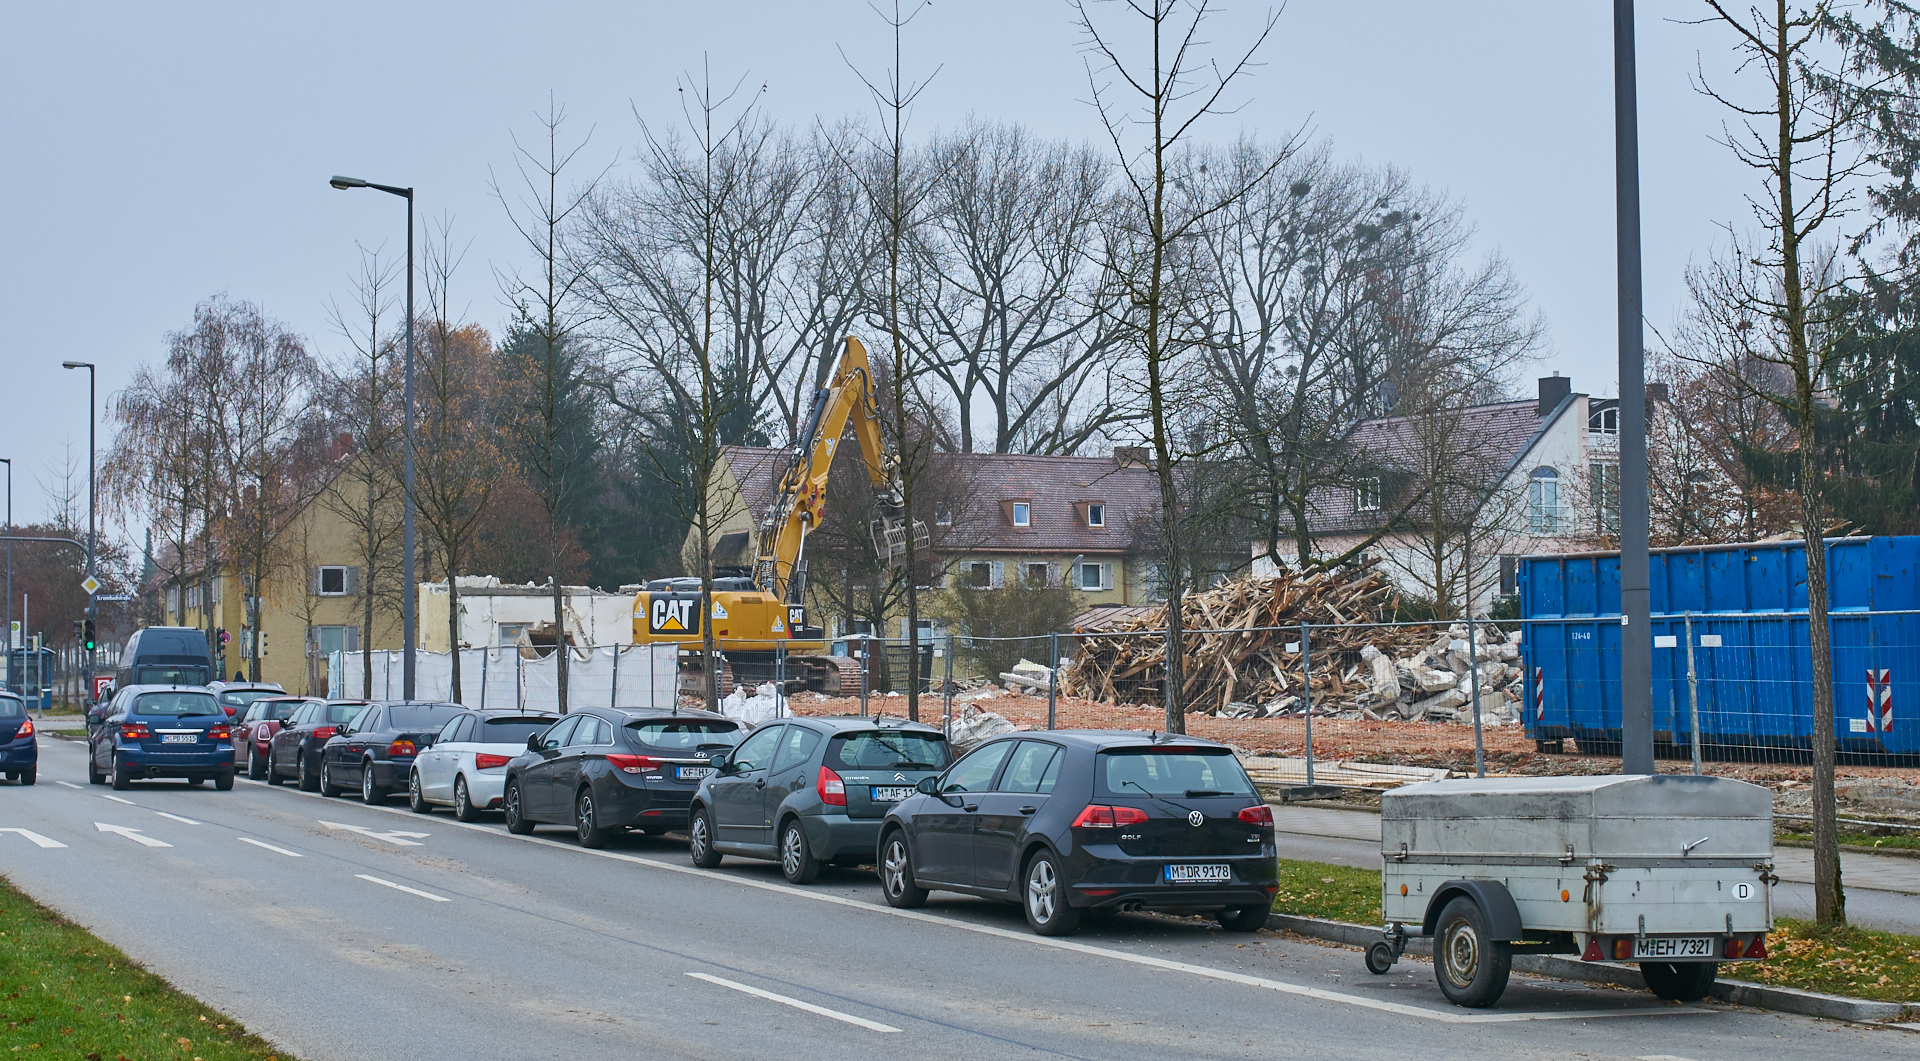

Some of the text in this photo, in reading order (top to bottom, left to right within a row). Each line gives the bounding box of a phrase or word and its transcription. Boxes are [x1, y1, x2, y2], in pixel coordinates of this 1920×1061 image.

[652, 599, 693, 630] CAT
[789, 608, 803, 623] CAT
[1571, 632, 1591, 640] 124-40
[682, 768, 694, 777] KF
[877, 788, 884, 798] M
[890, 788, 901, 798] AF
[1171, 865, 1229, 878] M DR 9178
[1738, 884, 1748, 899] D
[1637, 938, 1710, 955] M EH 7321
